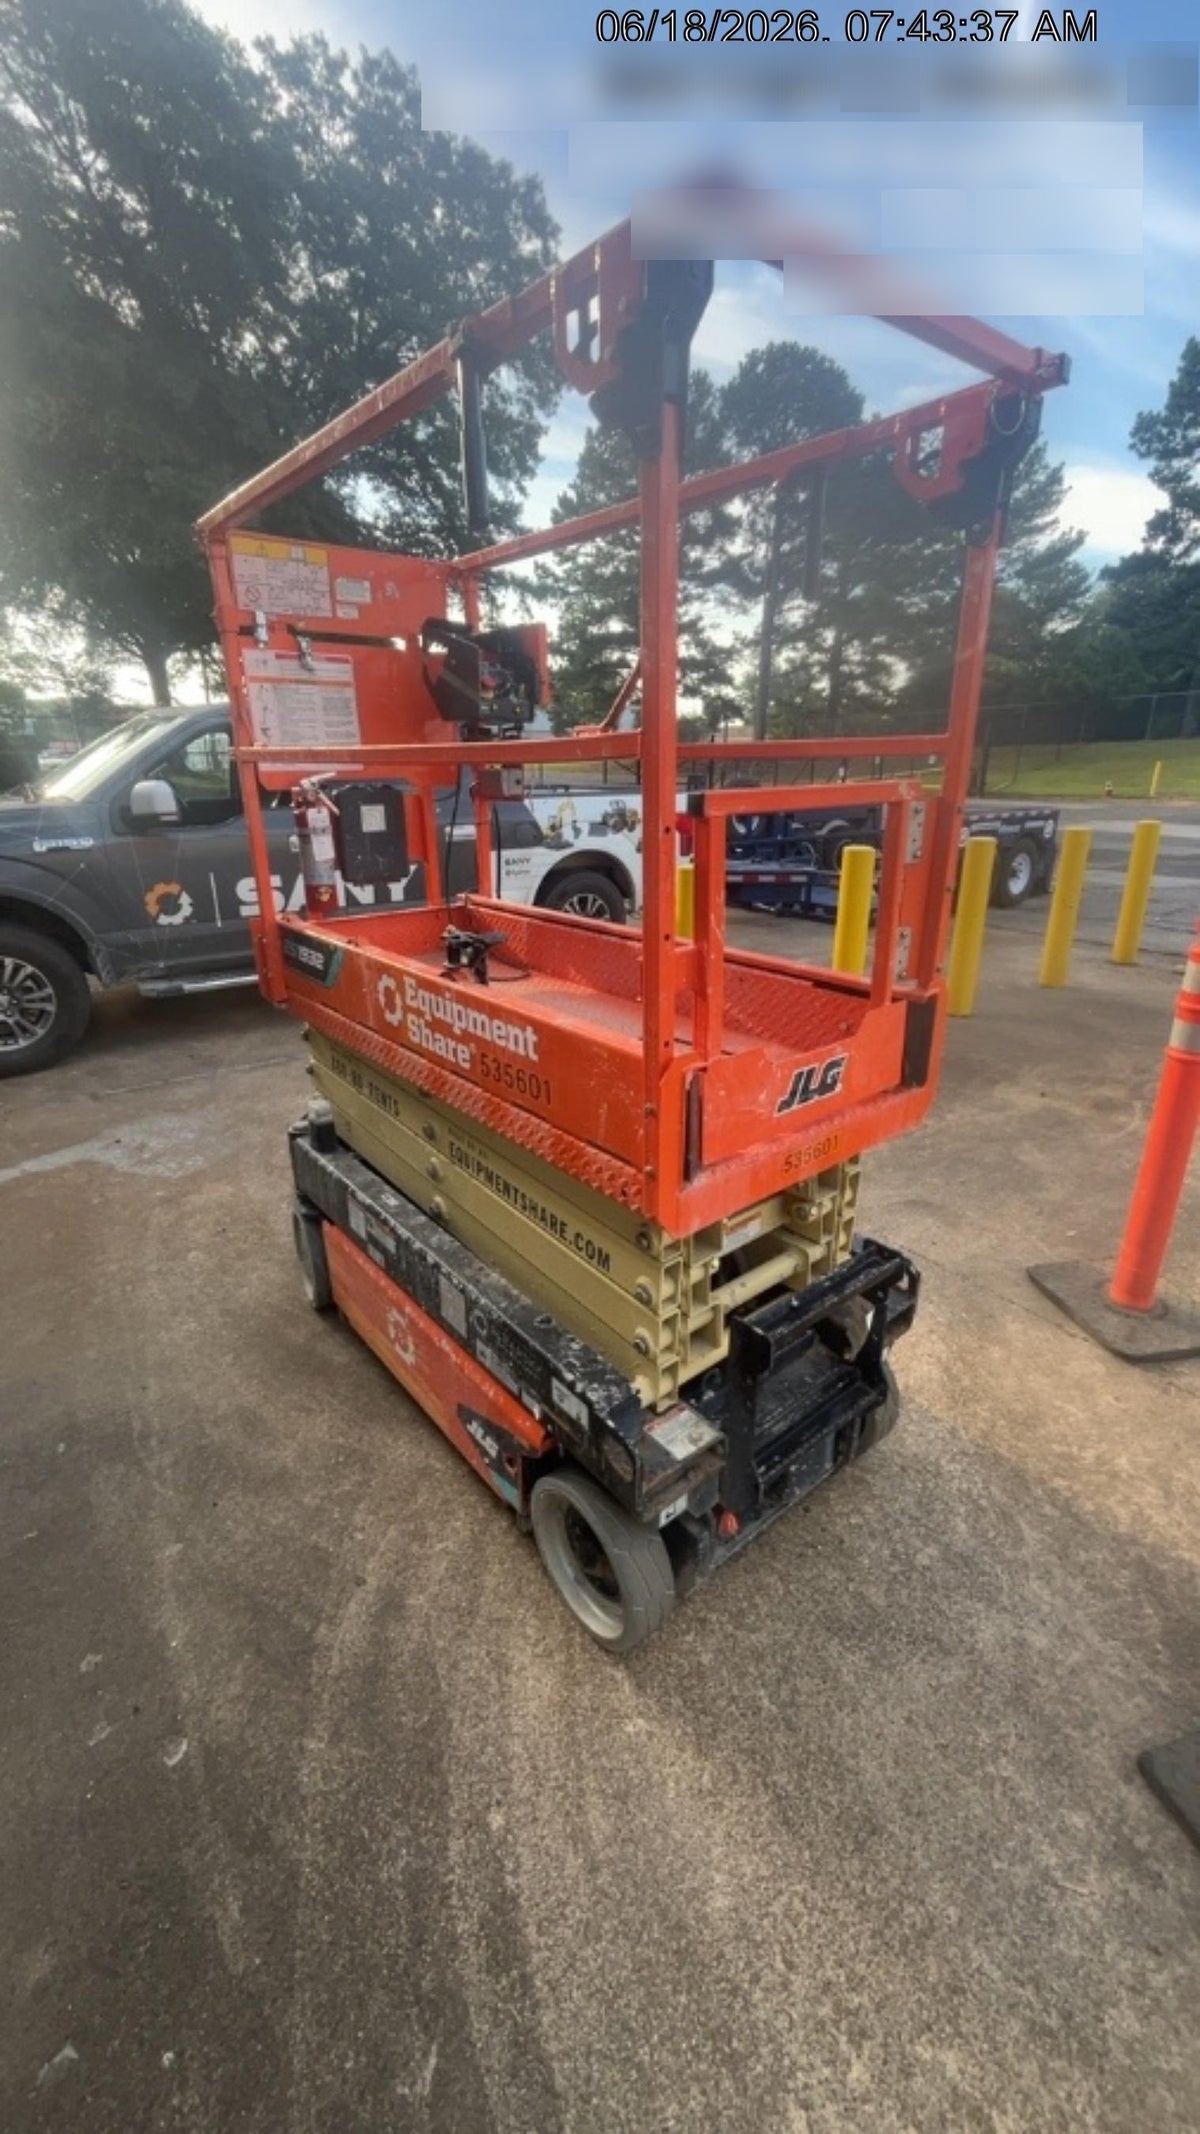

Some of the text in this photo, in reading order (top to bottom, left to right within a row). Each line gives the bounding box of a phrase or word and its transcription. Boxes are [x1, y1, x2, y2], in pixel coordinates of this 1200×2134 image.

[403, 976, 539, 1063] Equipment
[407, 1013, 471, 1071] Share
[480, 1053, 551, 1106] 535601
[775, 1054, 848, 1116] JLG
[450, 1142, 611, 1273] EQUIPMENTSHARE.COM
